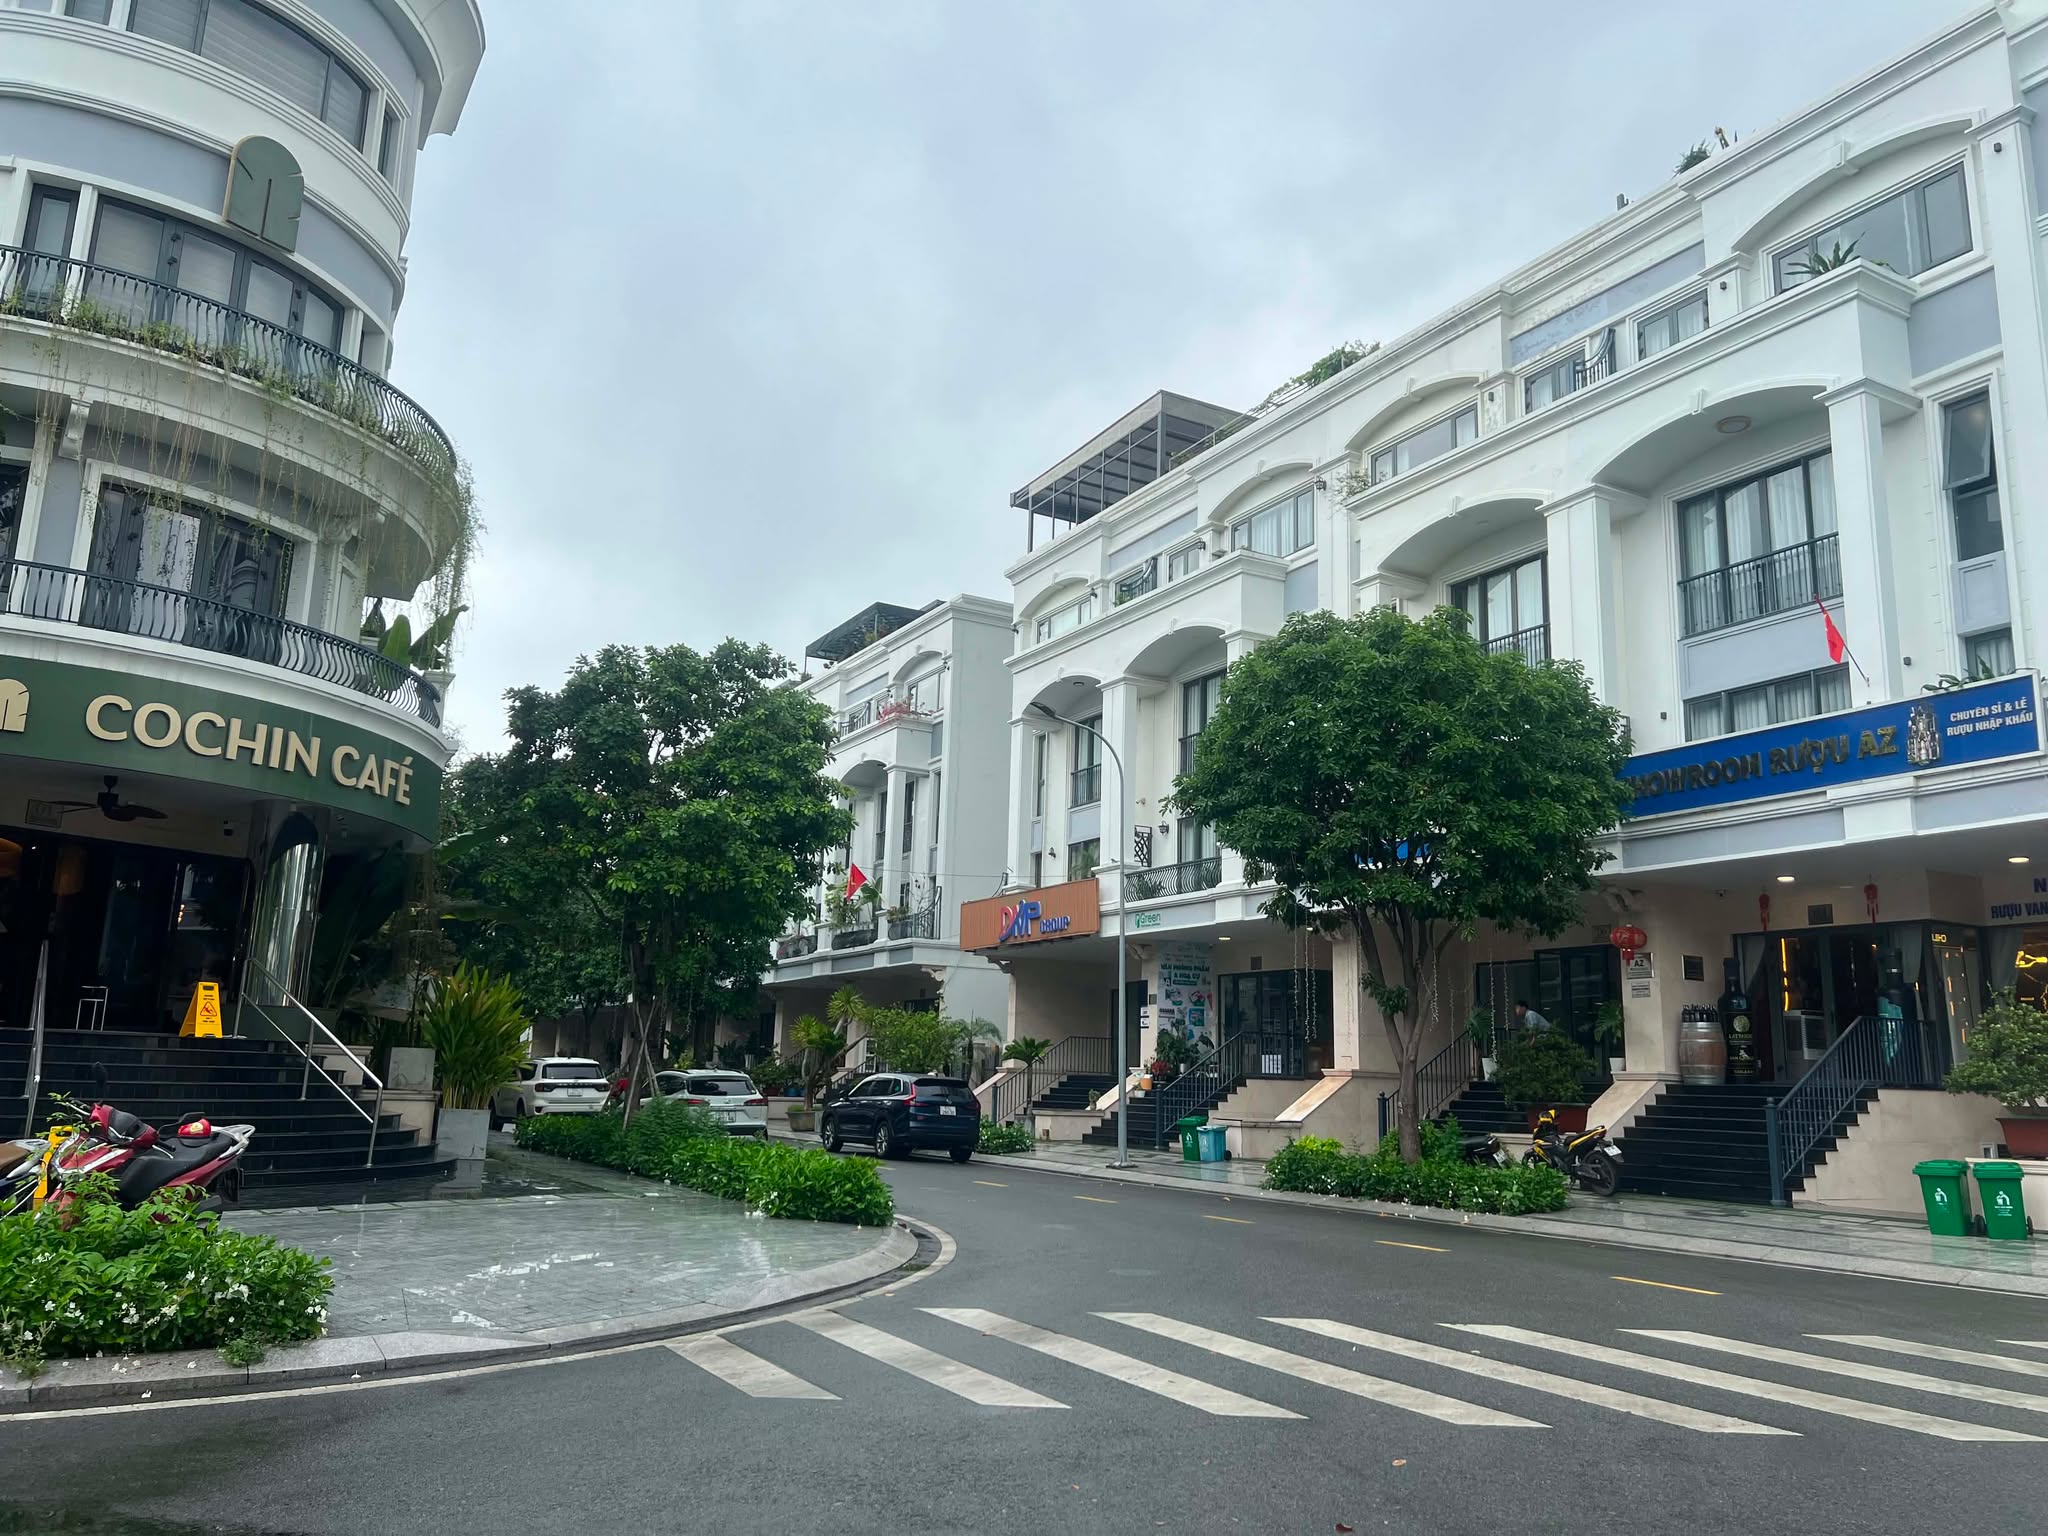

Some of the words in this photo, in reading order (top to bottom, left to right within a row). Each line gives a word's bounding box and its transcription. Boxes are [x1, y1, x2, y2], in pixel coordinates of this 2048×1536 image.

[1949, 706, 1989, 722] CHUYÊN
[2004, 702, 2013, 712] &
[2015, 696, 2028, 710] LẺ
[1946, 722, 1973, 737] RƯỢU
[1975, 717, 2003, 731] NHẬP
[86, 694, 321, 777] COCHIN
[331, 745, 414, 806] CAFÉ
[1768, 734, 1849, 775] RƯỢU
[1857, 725, 1899, 760] AZ
[1040, 916, 1071, 934] GROUP
[1141, 912, 1161, 924] Green
